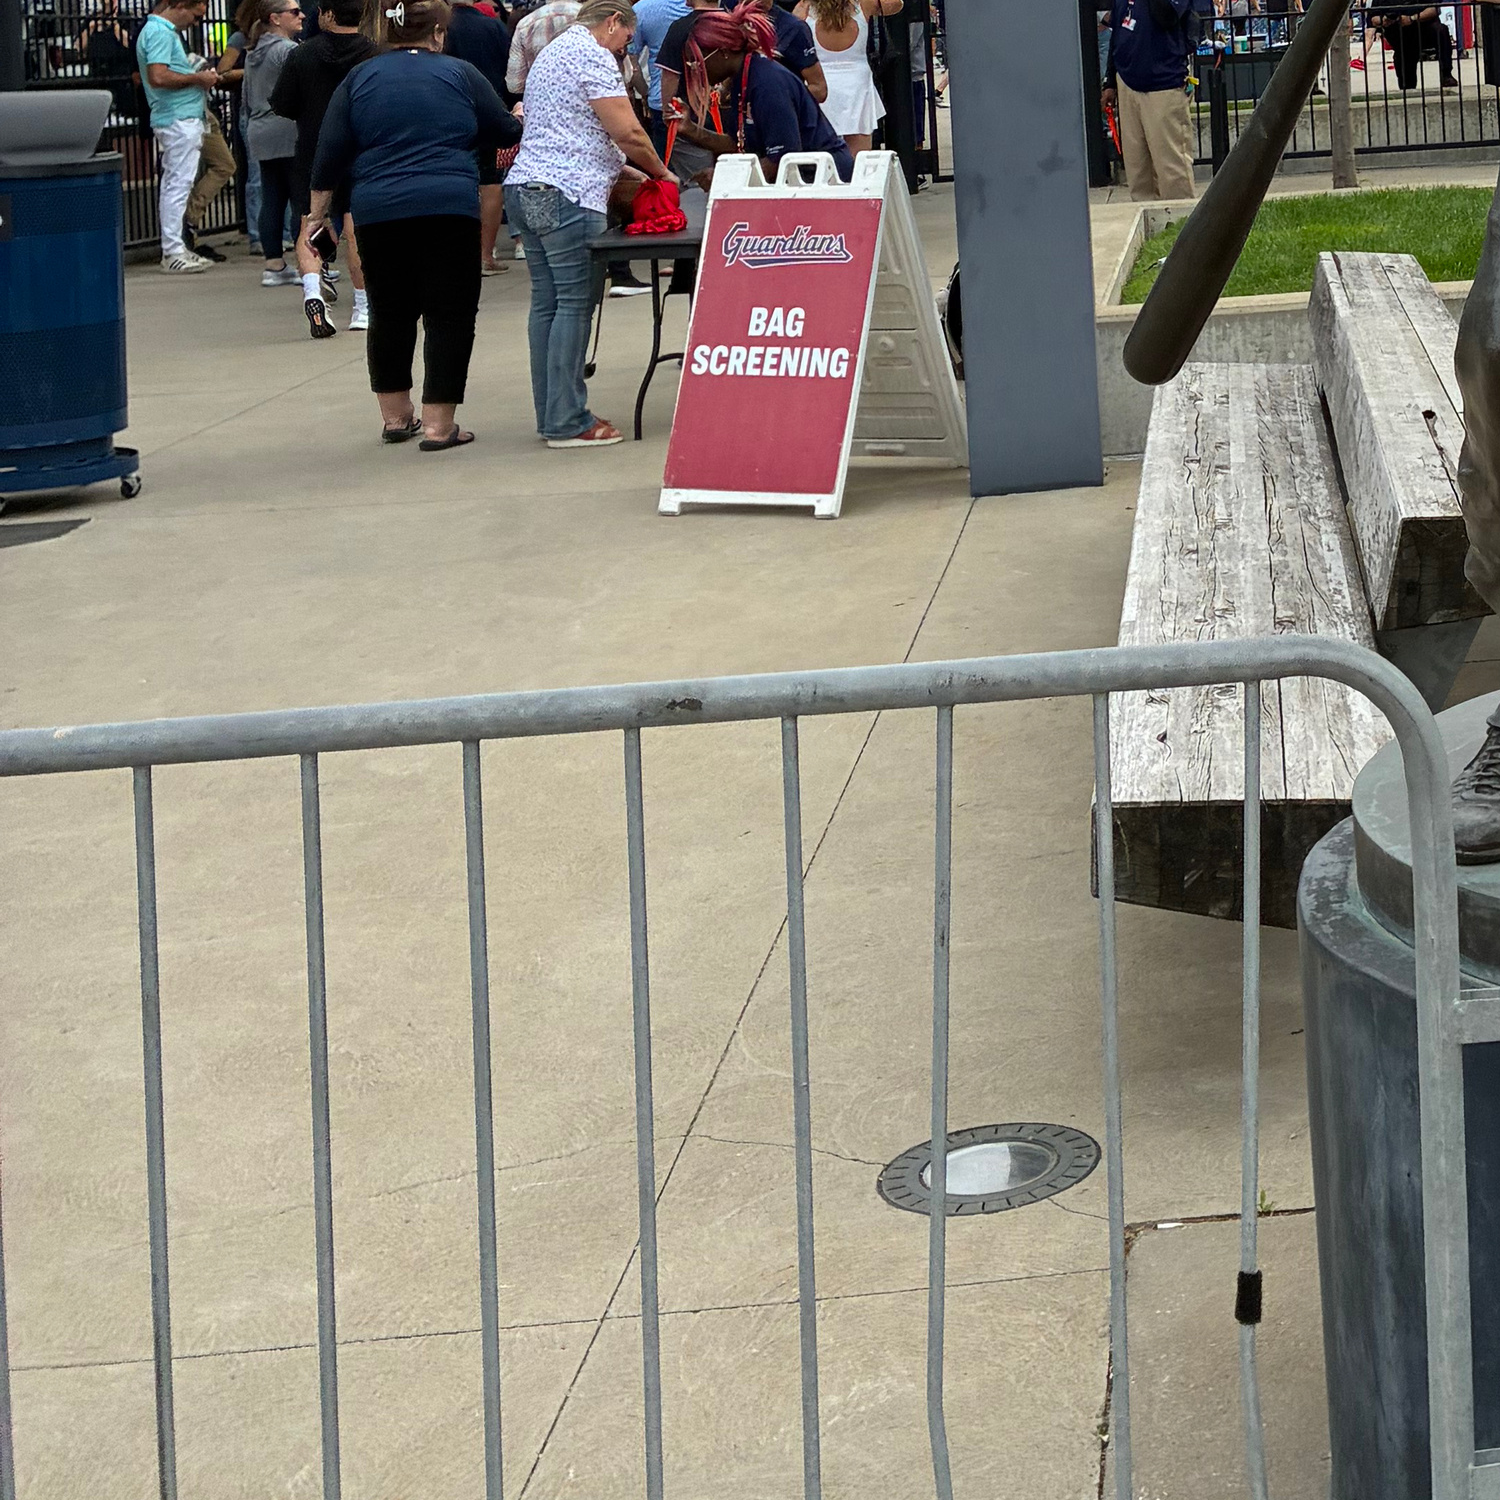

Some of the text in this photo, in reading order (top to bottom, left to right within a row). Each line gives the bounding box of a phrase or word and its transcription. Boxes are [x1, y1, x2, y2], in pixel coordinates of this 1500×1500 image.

[722, 221, 854, 269] Guardians
[748, 307, 805, 337] BAG
[691, 344, 850, 378] SCREENING
